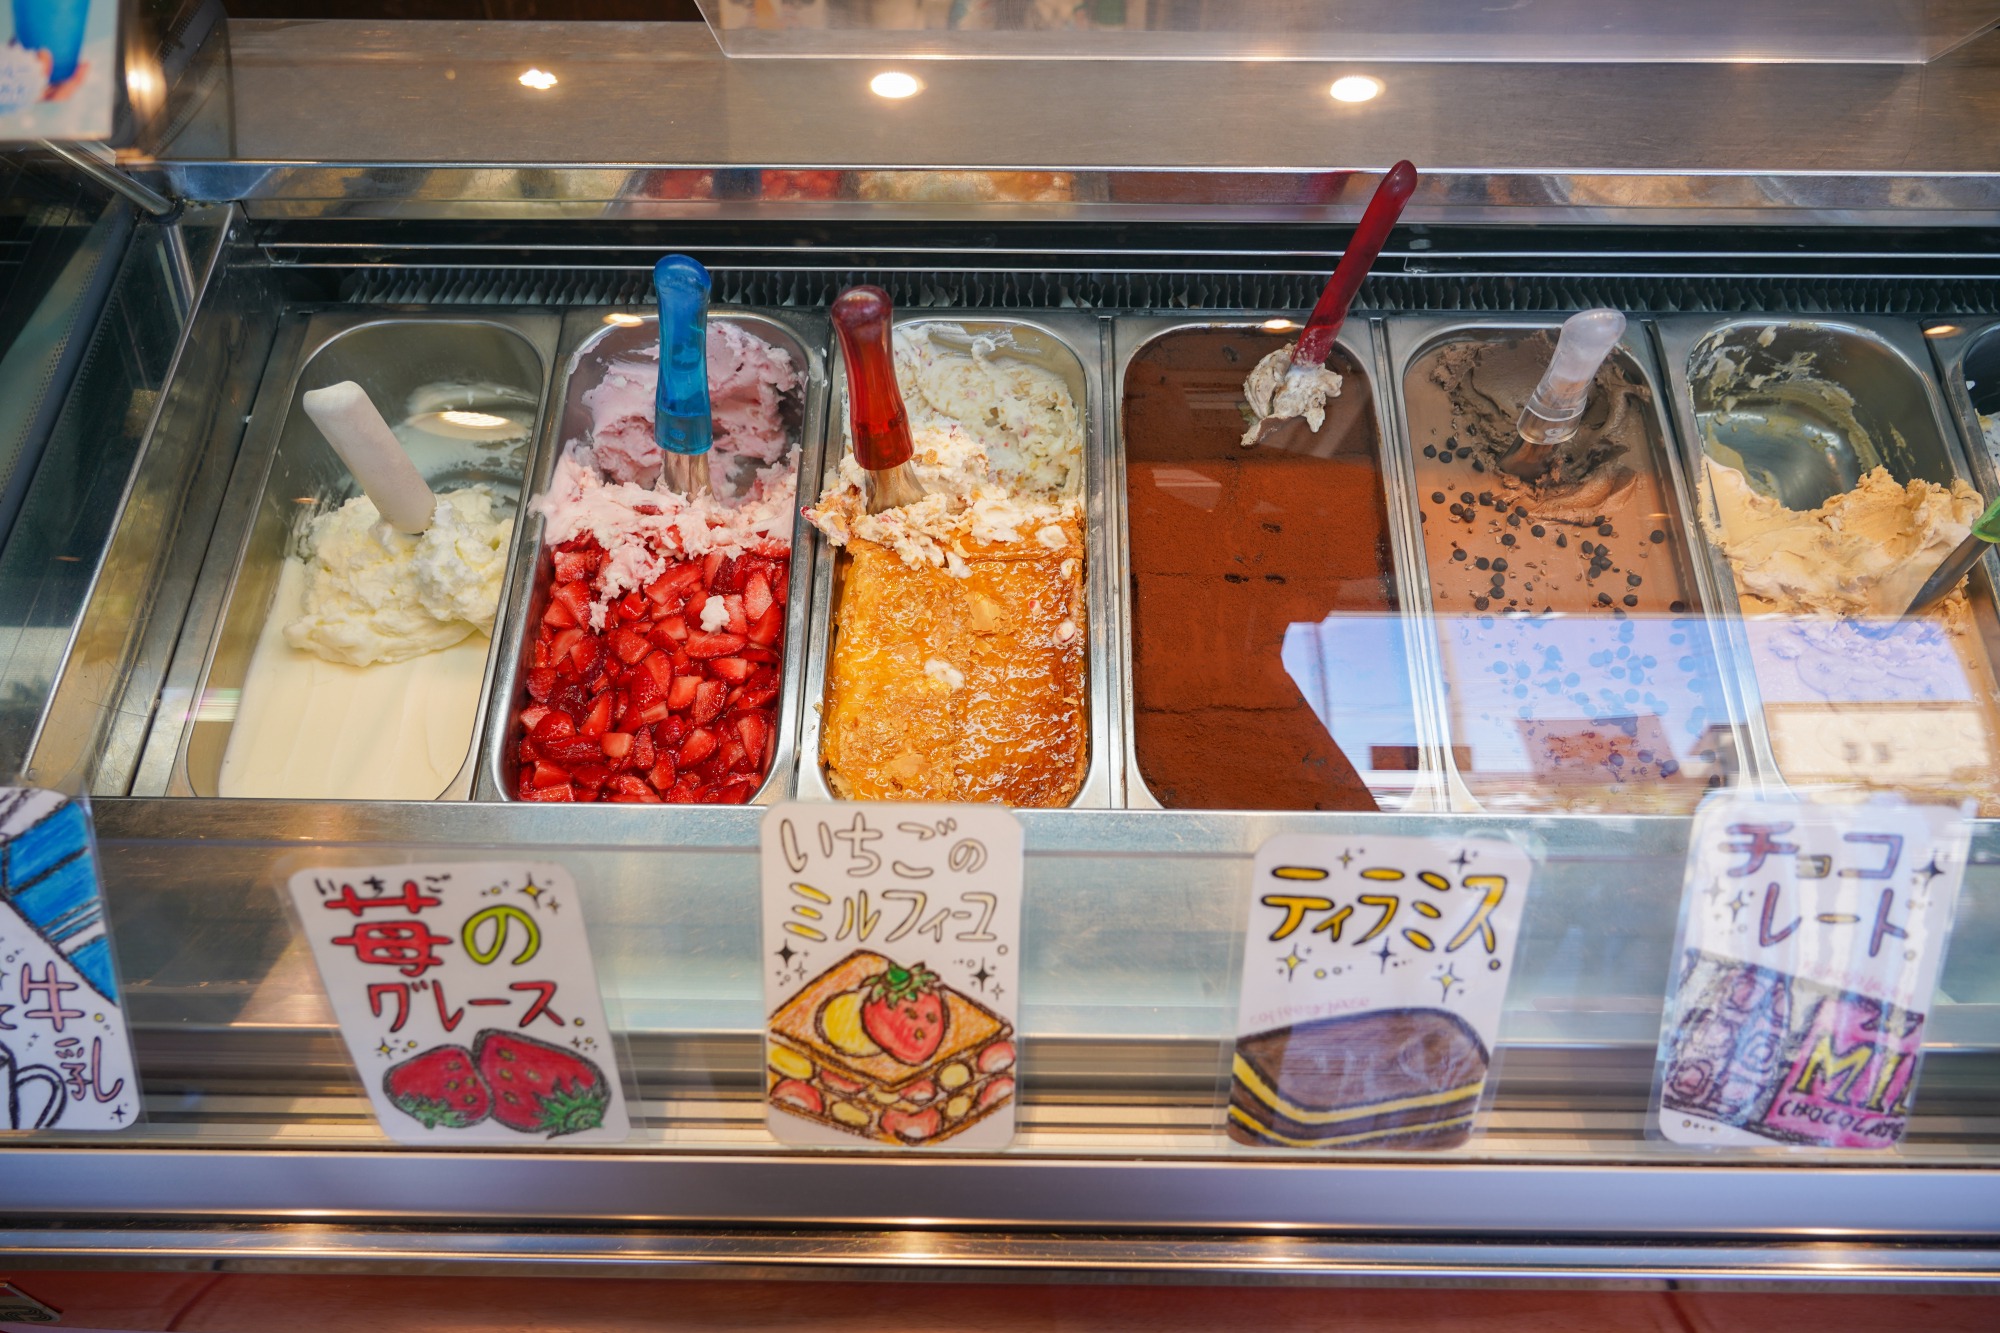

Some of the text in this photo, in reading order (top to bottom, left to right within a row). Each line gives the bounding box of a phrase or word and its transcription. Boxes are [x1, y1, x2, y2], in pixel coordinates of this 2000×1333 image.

[780, 811, 988, 878] いちごの
[1717, 821, 1904, 879] チョコ
[324, 880, 541, 978] 苺の
[1758, 882, 1910, 958] レート
